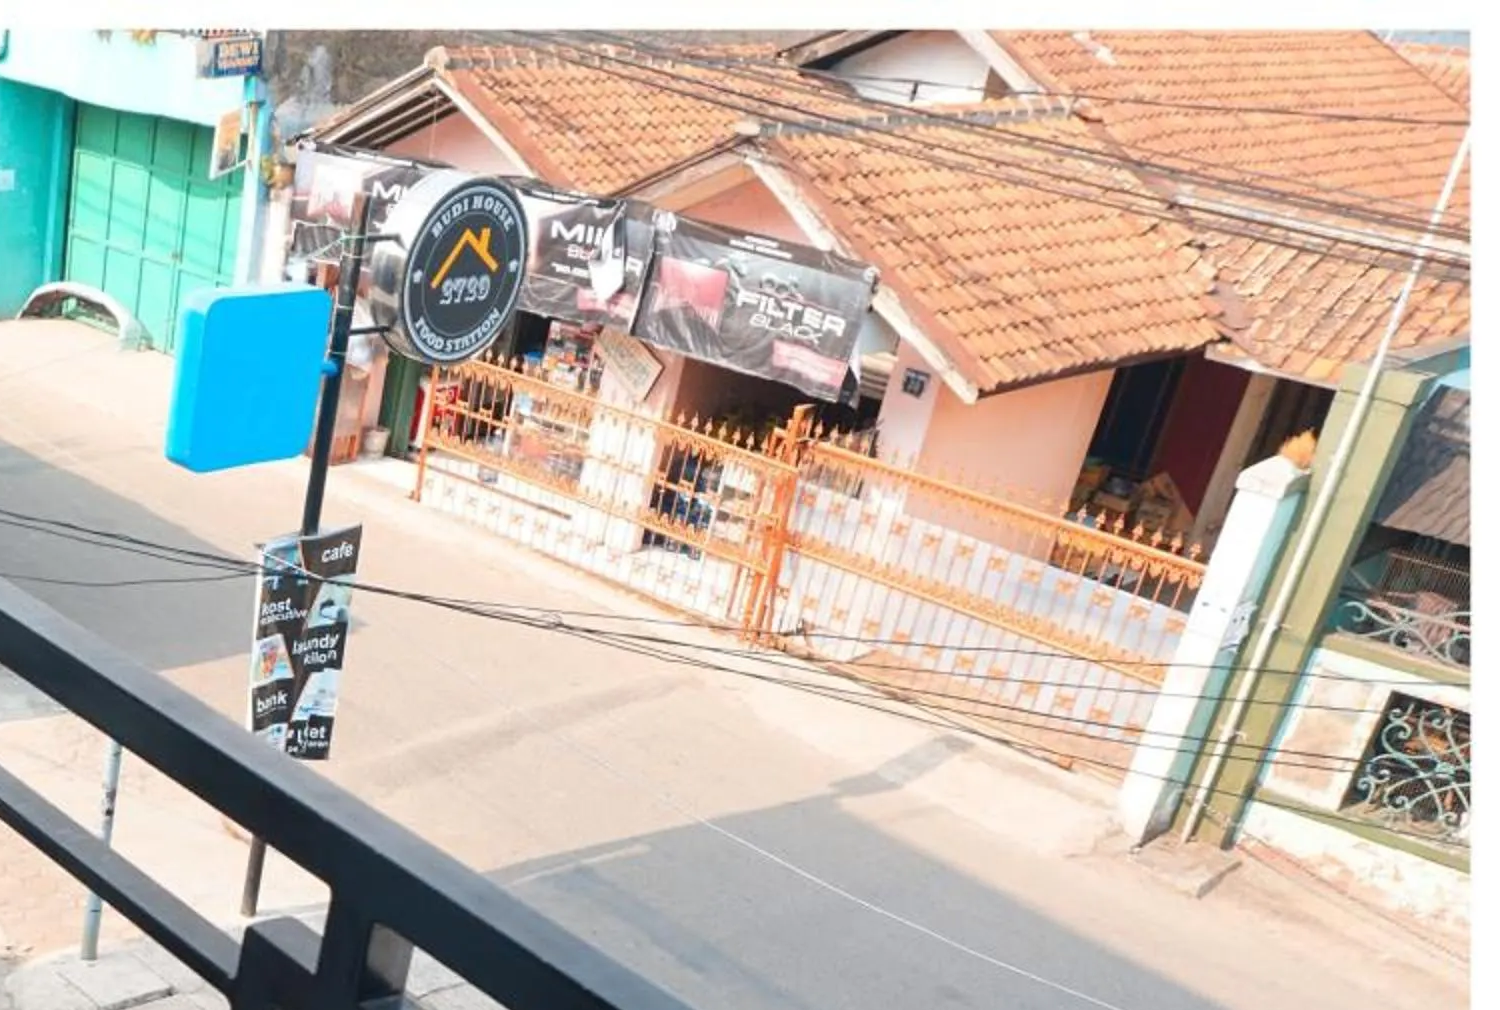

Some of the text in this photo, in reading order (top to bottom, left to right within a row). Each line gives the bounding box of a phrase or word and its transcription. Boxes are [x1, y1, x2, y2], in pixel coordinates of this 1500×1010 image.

[432, 197, 469, 238] BUDI
[472, 195, 515, 232] HOUSE
[446, 307, 501, 352] STATION
[737, 290, 846, 338] FILTER
[750, 313, 823, 345] BLACK
[322, 541, 354, 563] cafe
[261, 598, 291, 617] kost
[257, 690, 288, 713] bank
